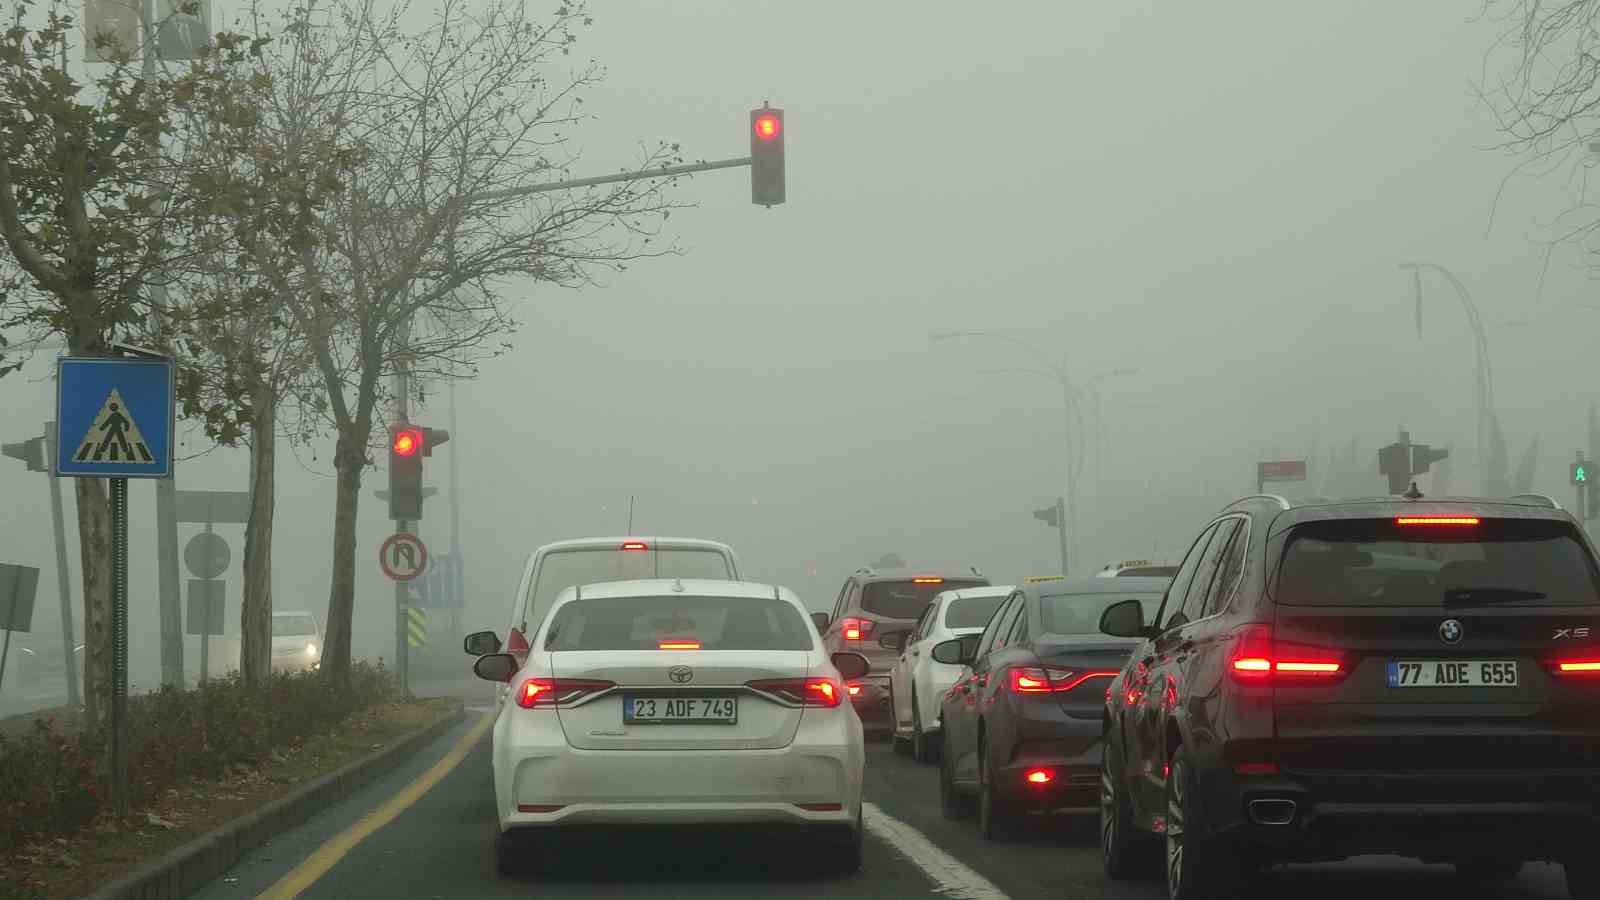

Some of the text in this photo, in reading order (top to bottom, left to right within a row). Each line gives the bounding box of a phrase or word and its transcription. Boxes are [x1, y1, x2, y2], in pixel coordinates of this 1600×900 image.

[1399, 664, 1515, 684] 77 ADE 655
[636, 700, 733, 717] 23 ADF 749
